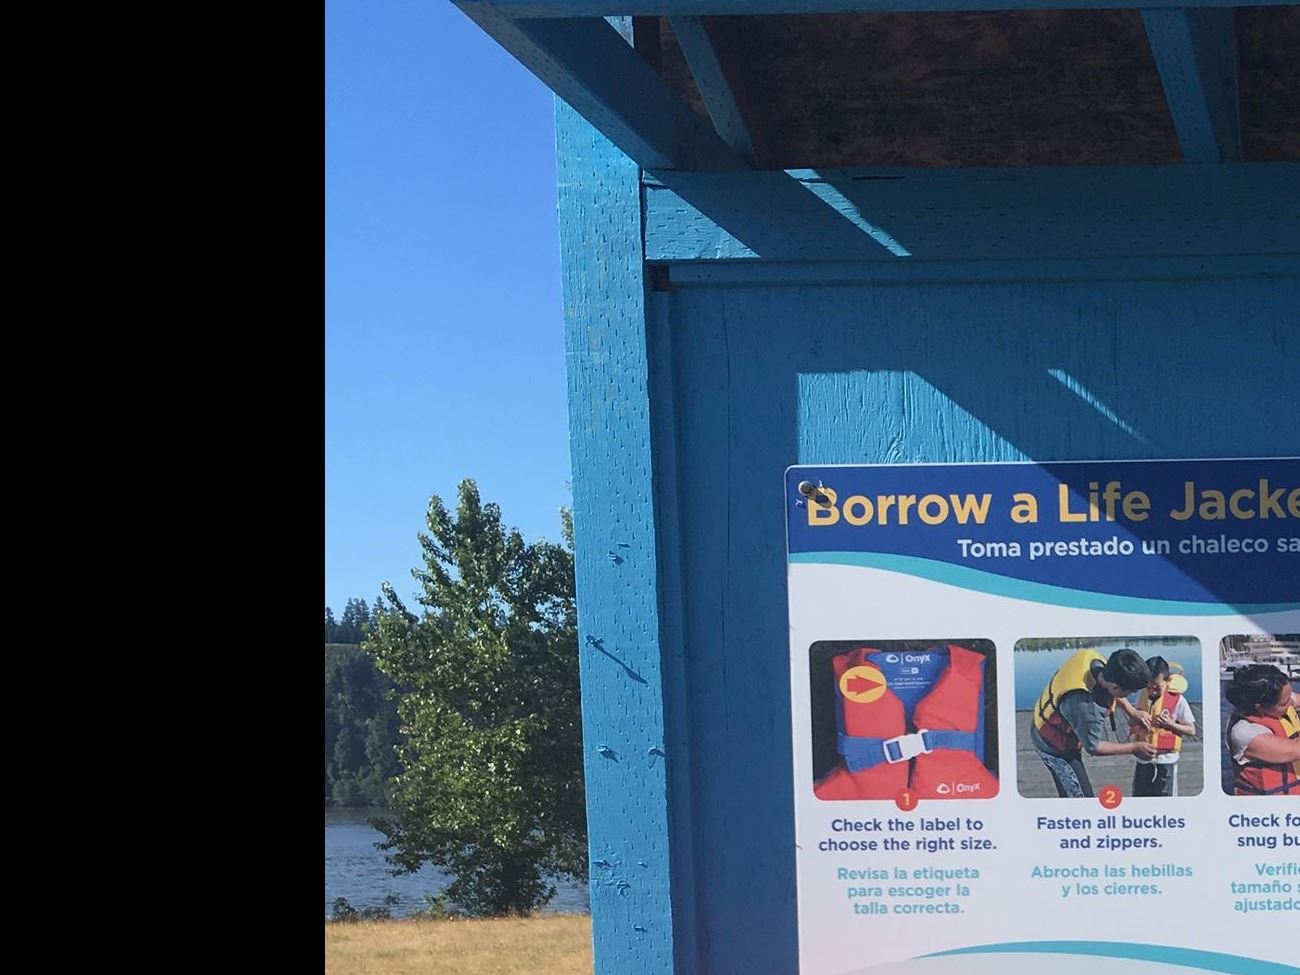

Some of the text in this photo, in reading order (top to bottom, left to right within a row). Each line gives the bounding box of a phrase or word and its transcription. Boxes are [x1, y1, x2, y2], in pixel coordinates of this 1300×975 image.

[807, 487, 992, 526] Borrow
[1011, 493, 1037, 523] a
[1059, 482, 1150, 522] Life
[957, 540, 1021, 557] Toma
[1030, 536, 1133, 560] prestado
[1143, 541, 1169, 555] un
[1179, 535, 1268, 553] chaleco
[902, 792, 912, 806] 1
[1105, 790, 1116, 804] 2
[832, 818, 983, 832] Check the label to
[1038, 815, 1185, 829] Fasten all buckles
[1229, 814, 1279, 827] Check
[819, 837, 996, 853] choose the right size.
[1060, 835, 1162, 851] and zippers.
[1238, 837, 1276, 849] snug
[838, 867, 979, 884] Revisa la etiqueta
[1031, 864, 1192, 878] Abrocha las hebillas
[848, 884, 970, 899] para escoger la
[1062, 882, 1162, 898] y los cierres.
[1231, 880, 1292, 893] tamaño
[854, 902, 964, 914] talla correcta.
